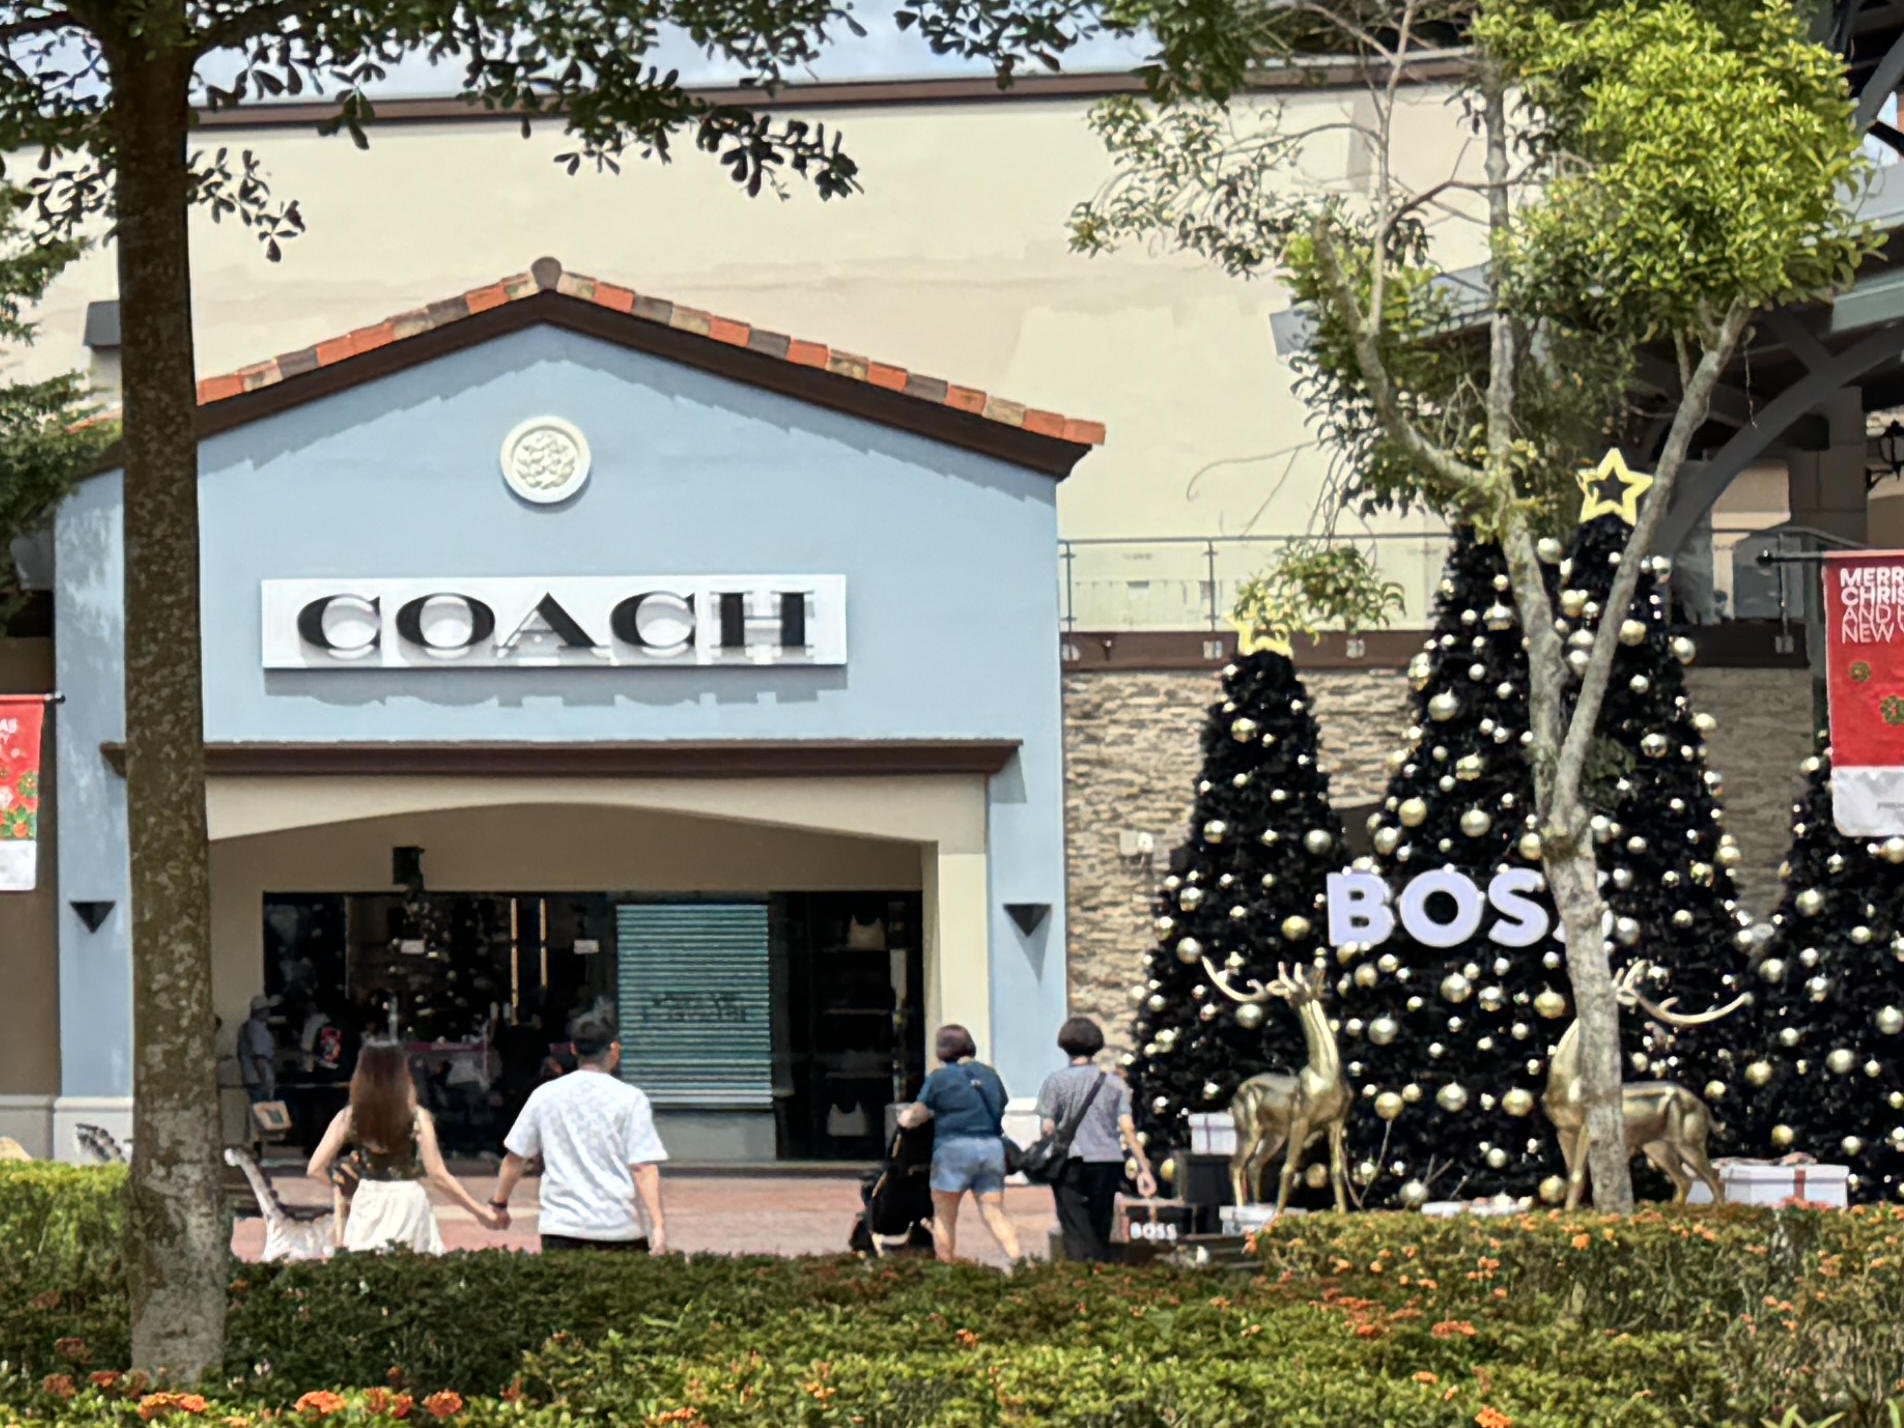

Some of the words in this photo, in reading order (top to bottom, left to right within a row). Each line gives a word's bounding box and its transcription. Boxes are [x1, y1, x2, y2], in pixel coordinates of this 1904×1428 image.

[296, 591, 816, 651] COACH
[1841, 622, 1895, 644] NEW
[1842, 605, 1892, 624] AND
[1326, 868, 1614, 947] BOS
